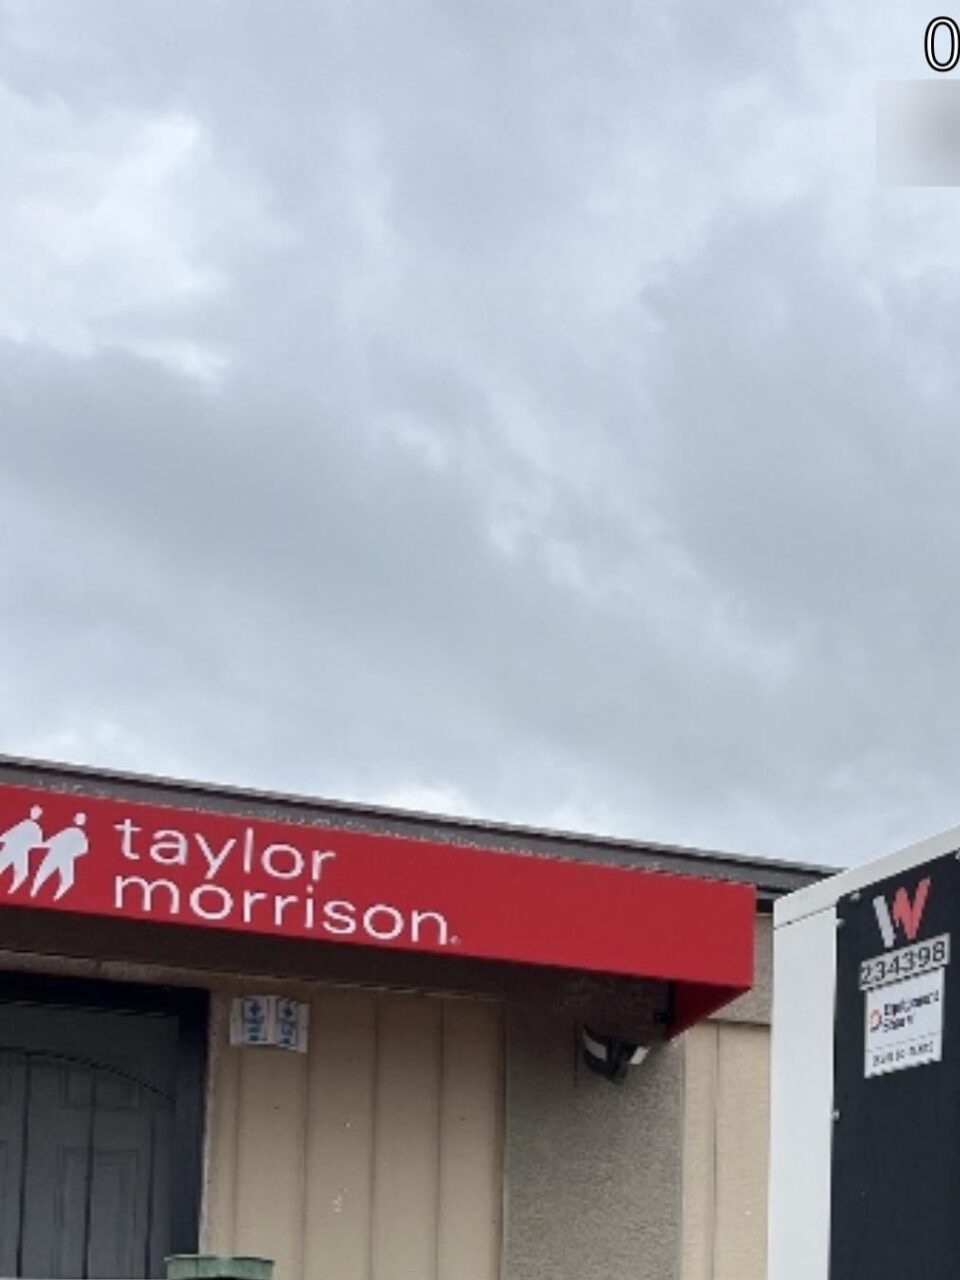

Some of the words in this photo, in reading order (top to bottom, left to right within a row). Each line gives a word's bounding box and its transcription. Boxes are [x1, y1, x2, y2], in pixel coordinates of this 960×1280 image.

[114, 818, 336, 880] taylor
[114, 875, 449, 945] morrison
[860, 941, 946, 986] 234398
